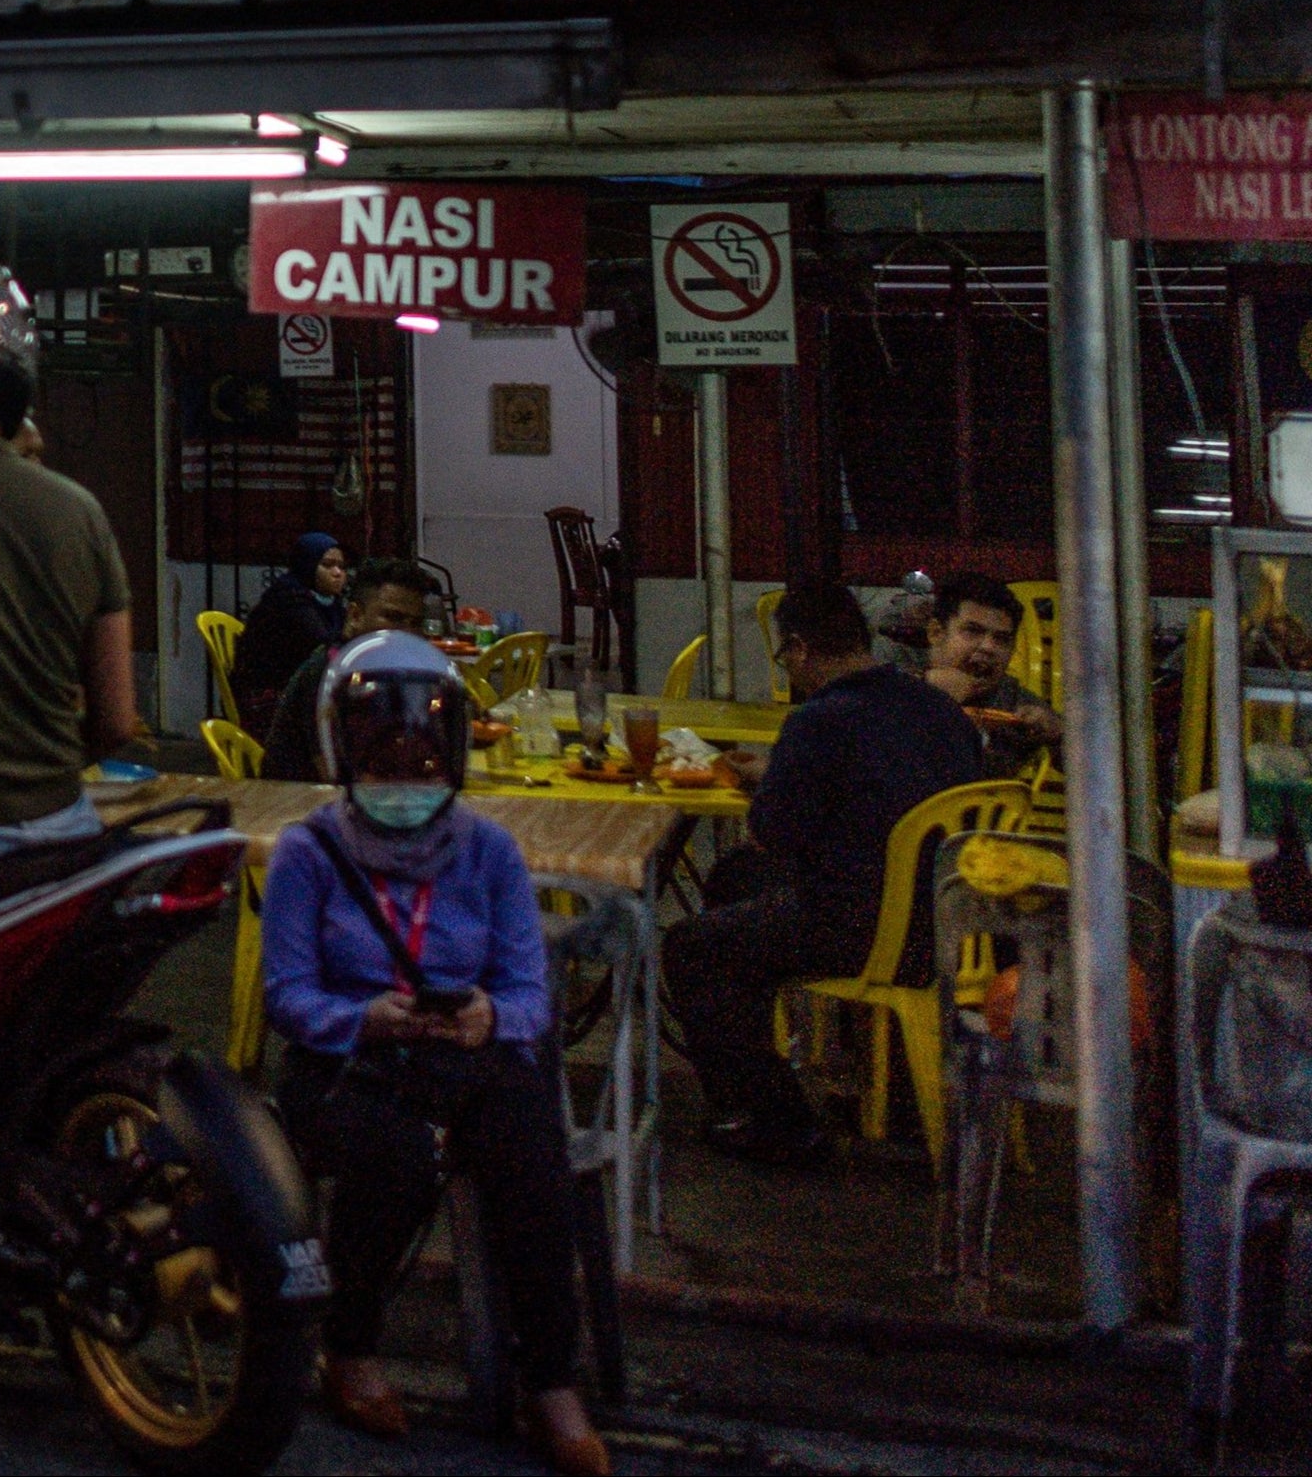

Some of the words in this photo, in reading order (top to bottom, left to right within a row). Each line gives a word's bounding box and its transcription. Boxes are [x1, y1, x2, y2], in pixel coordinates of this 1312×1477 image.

[1131, 112, 1293, 163] LONTONG
[1193, 172, 1271, 221] NASI
[340, 195, 495, 250] NASI
[273, 249, 557, 311] CAMPUR
[664, 330, 726, 344] DILARANG
[730, 329, 789, 343] MEROKOK
